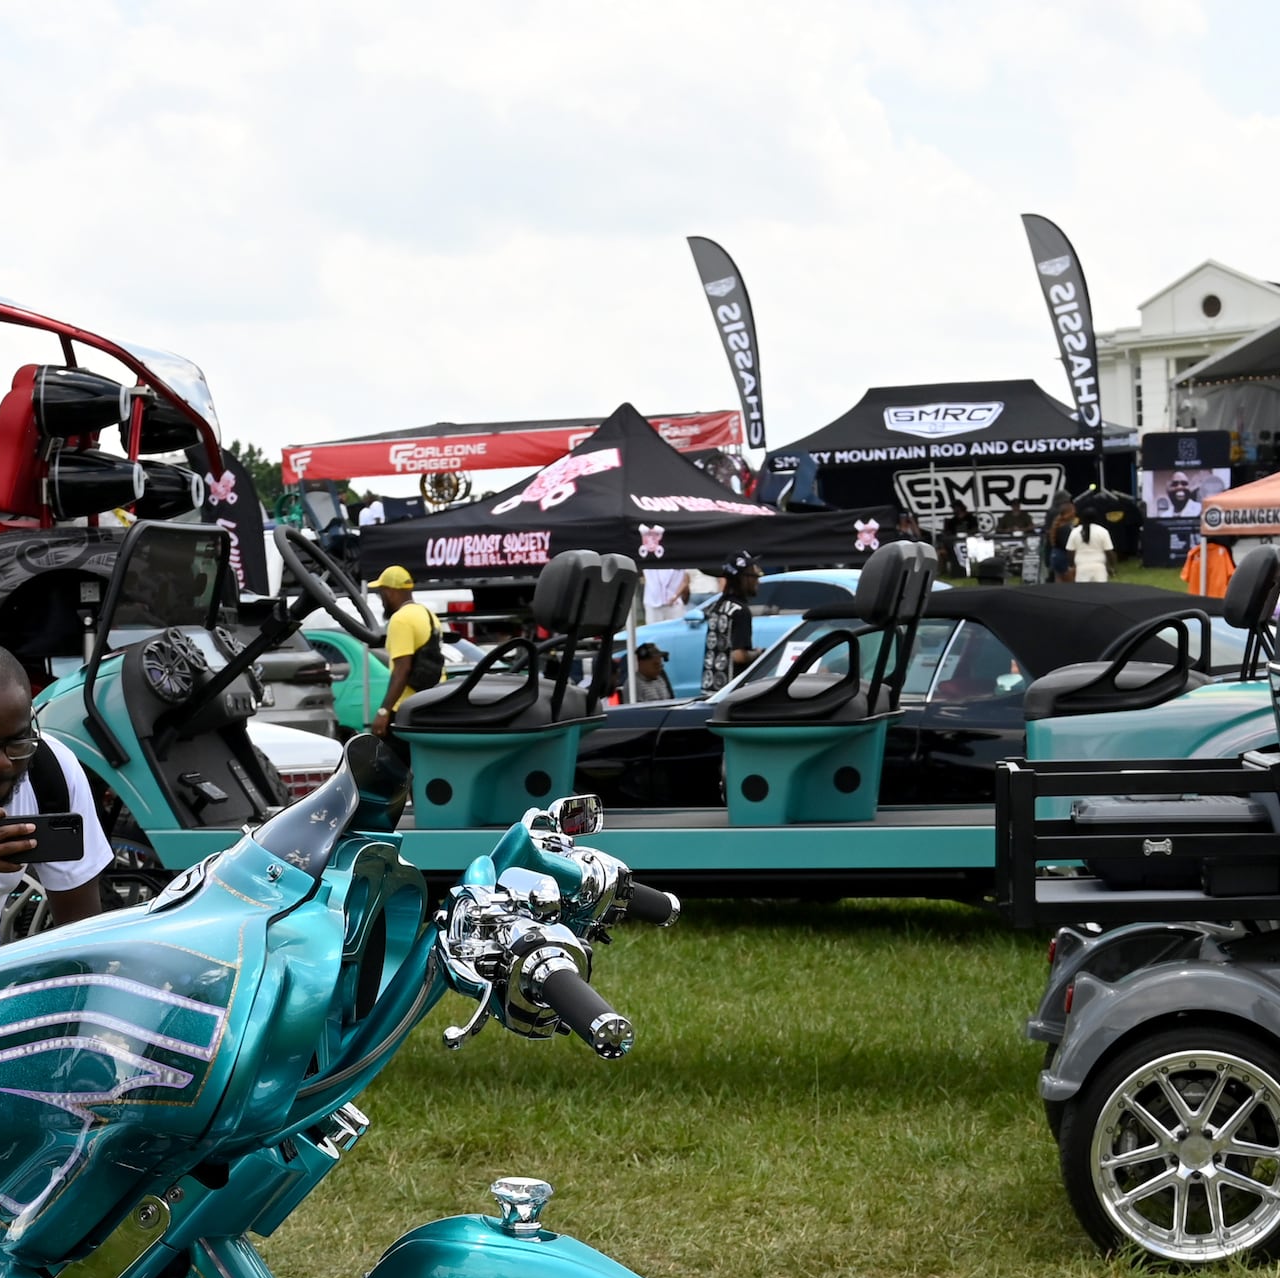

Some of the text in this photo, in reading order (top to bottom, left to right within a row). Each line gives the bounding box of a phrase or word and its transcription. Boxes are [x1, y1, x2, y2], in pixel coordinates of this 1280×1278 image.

[893, 405, 995, 423] SMRC
[835, 442, 926, 463] MOUNTAIN
[930, 442, 967, 457] ROD
[970, 440, 1010, 456] AND
[1011, 437, 1096, 453] CUSTOMS
[906, 473, 1053, 510] SMRC
[425, 531, 551, 567] LOW BOOST SOCIETY
